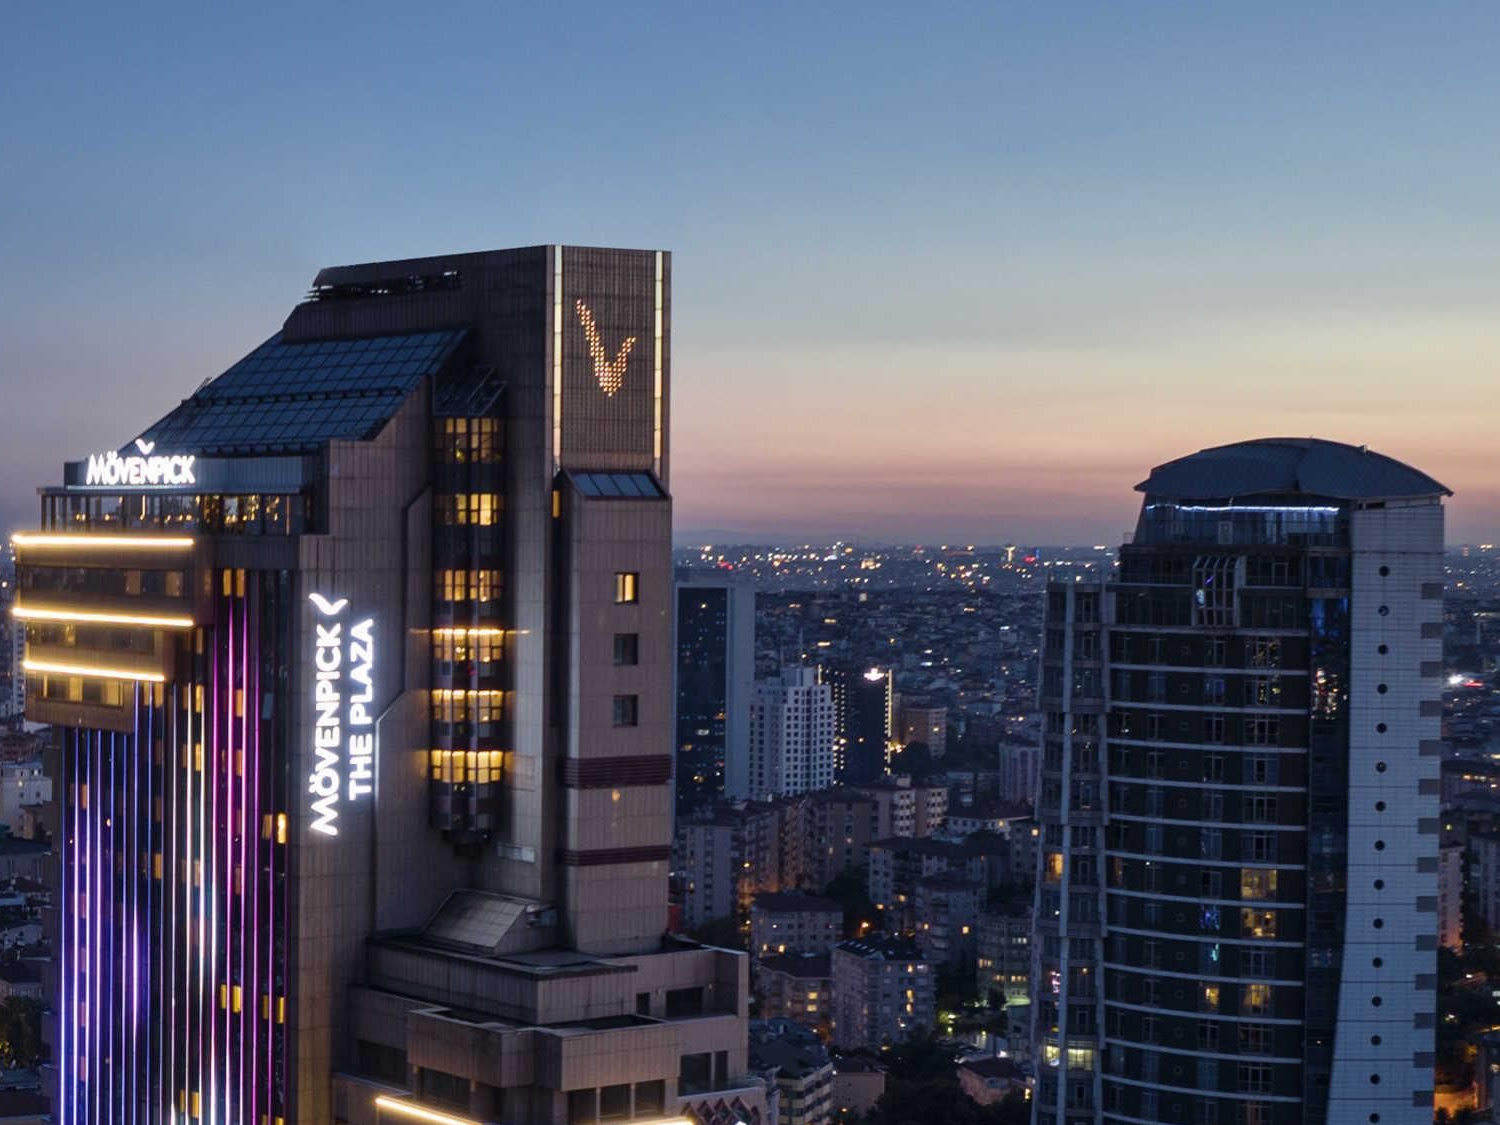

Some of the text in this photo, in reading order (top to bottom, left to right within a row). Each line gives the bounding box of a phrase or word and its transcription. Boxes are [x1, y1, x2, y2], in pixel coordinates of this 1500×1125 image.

[86, 450, 196, 485] MÖVENPICK
[309, 623, 342, 836] MÖVENPICK
[349, 619, 374, 801] THE PLAZA
